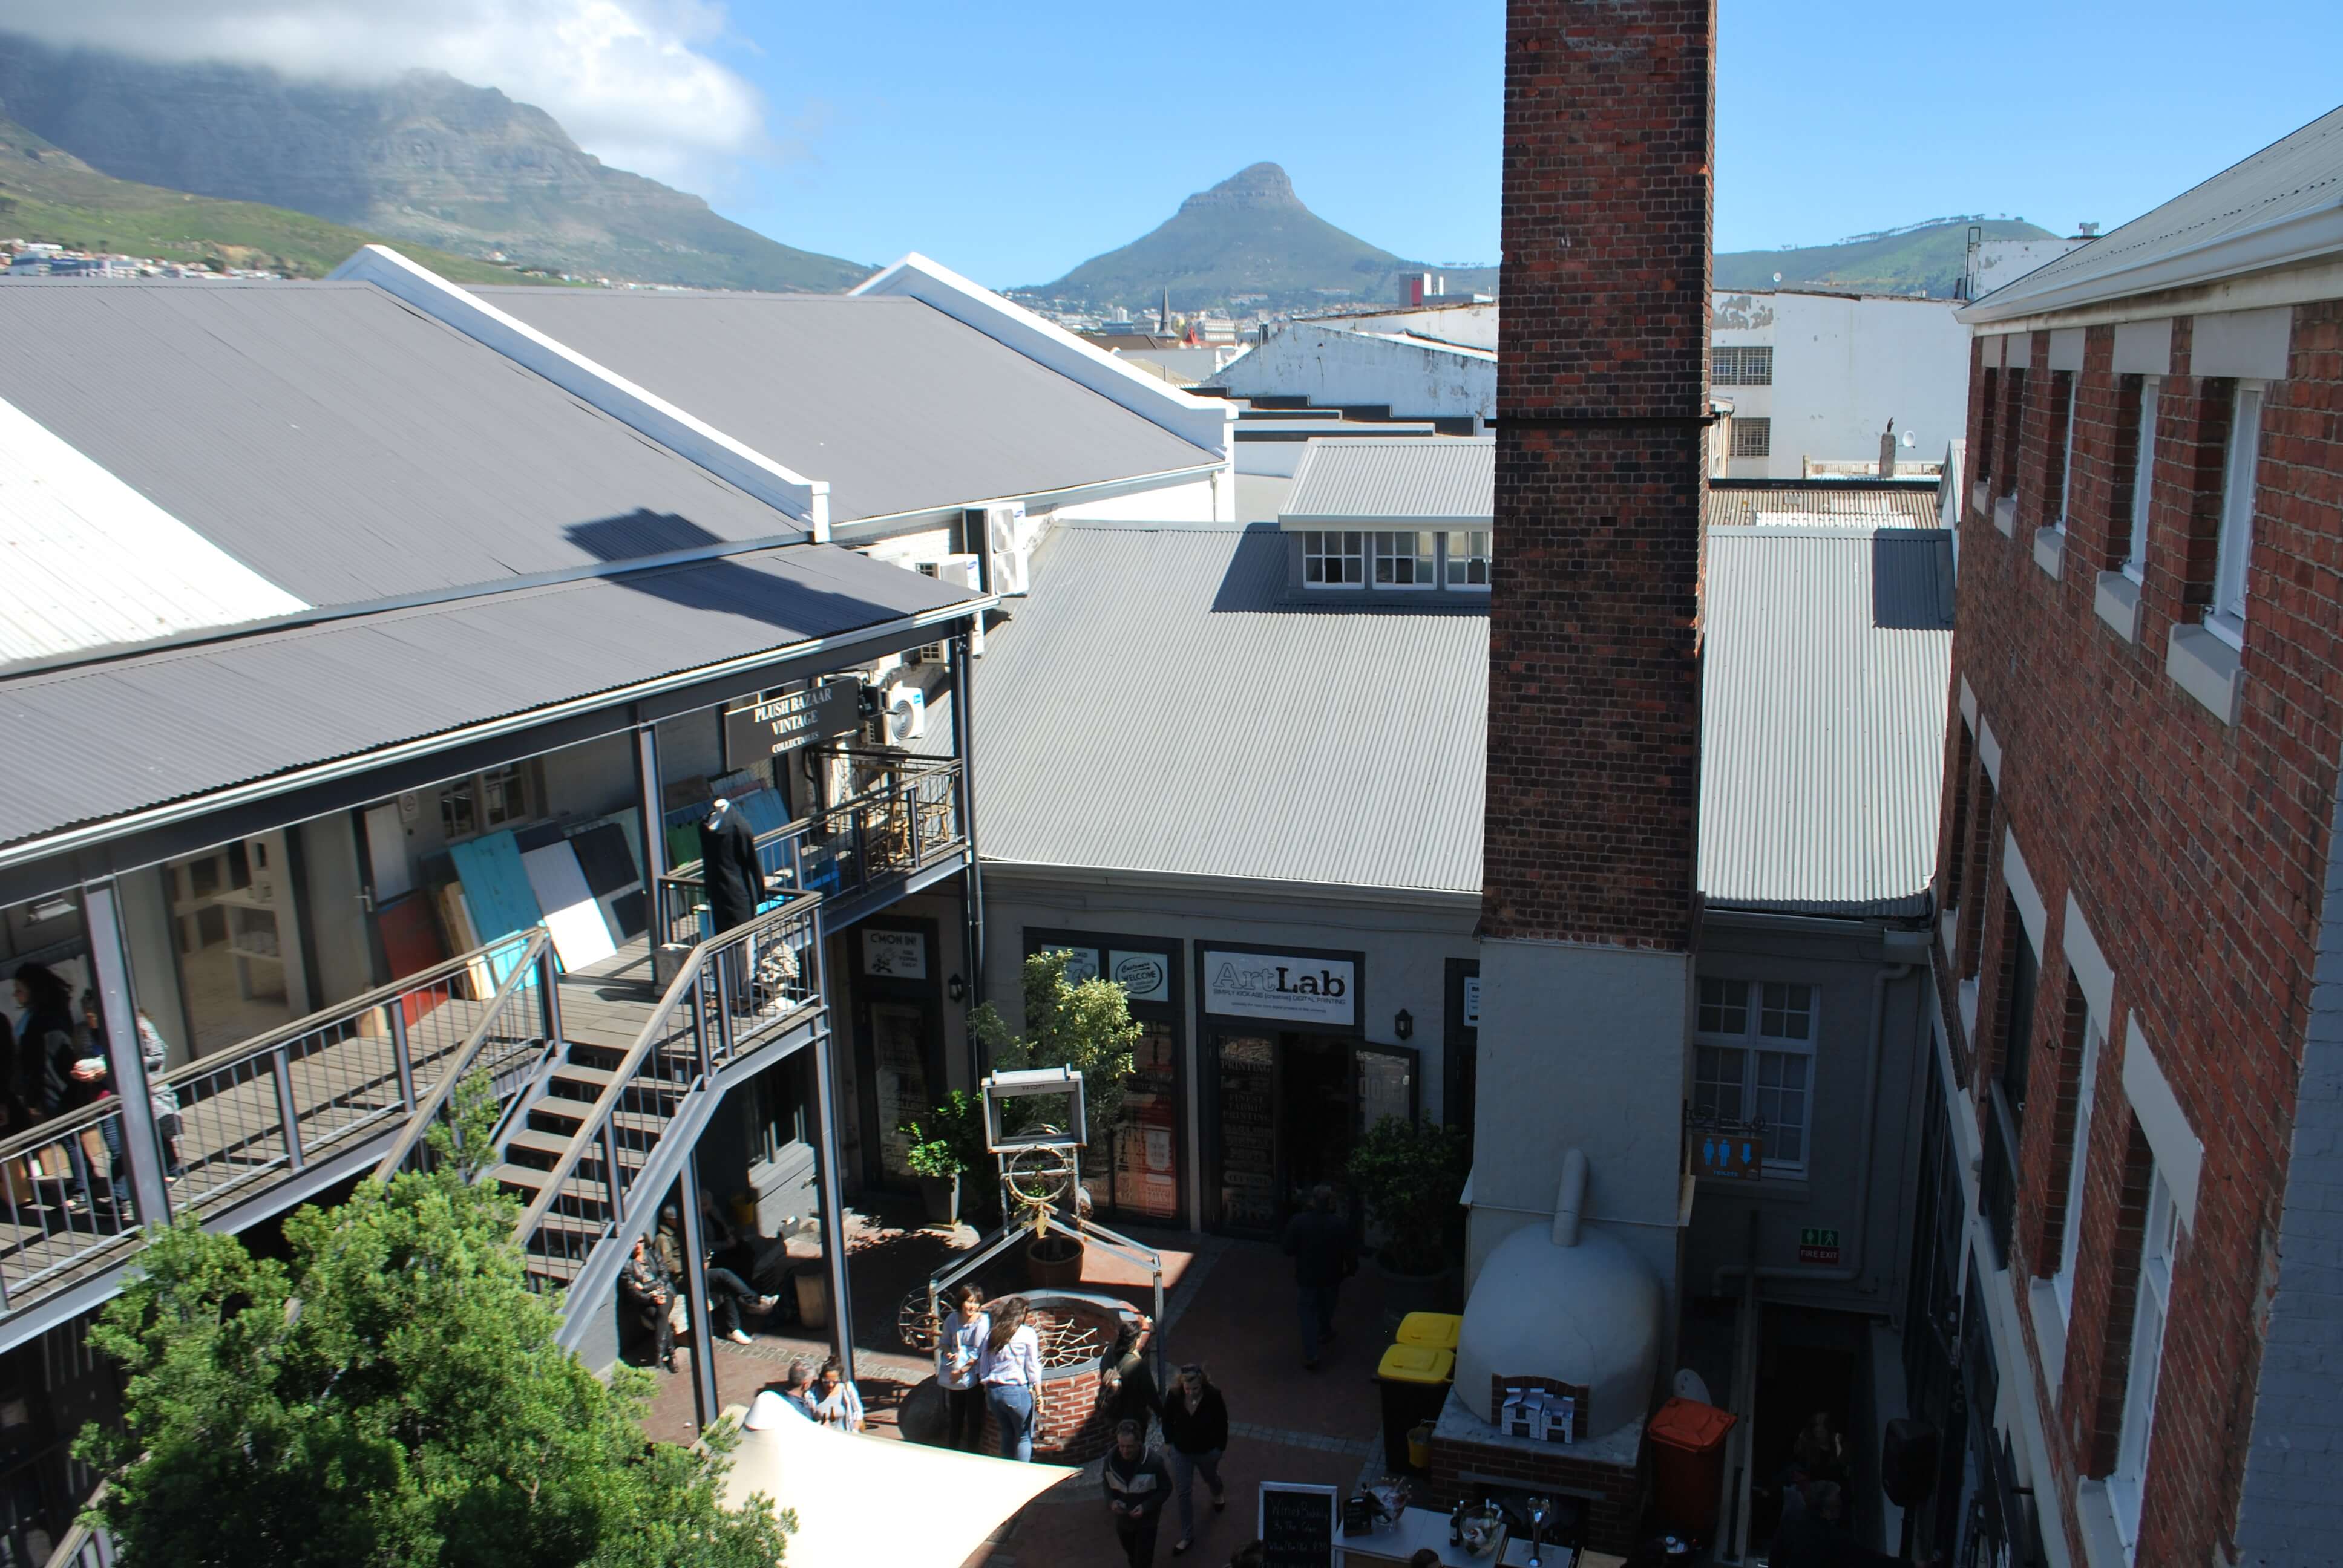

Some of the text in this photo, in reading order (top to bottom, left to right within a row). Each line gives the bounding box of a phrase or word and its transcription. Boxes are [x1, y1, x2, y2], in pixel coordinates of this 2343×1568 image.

[754, 688, 833, 723] PLUSH BAZAAR
[772, 710, 818, 735] VINTAGE
[1122, 970, 1157, 981] WELCOME
[1213, 962, 1345, 997] ArtLab
[1220, 1059, 1271, 1074] PRINTING
[1800, 1249, 1838, 1259] FIRE EXIT
